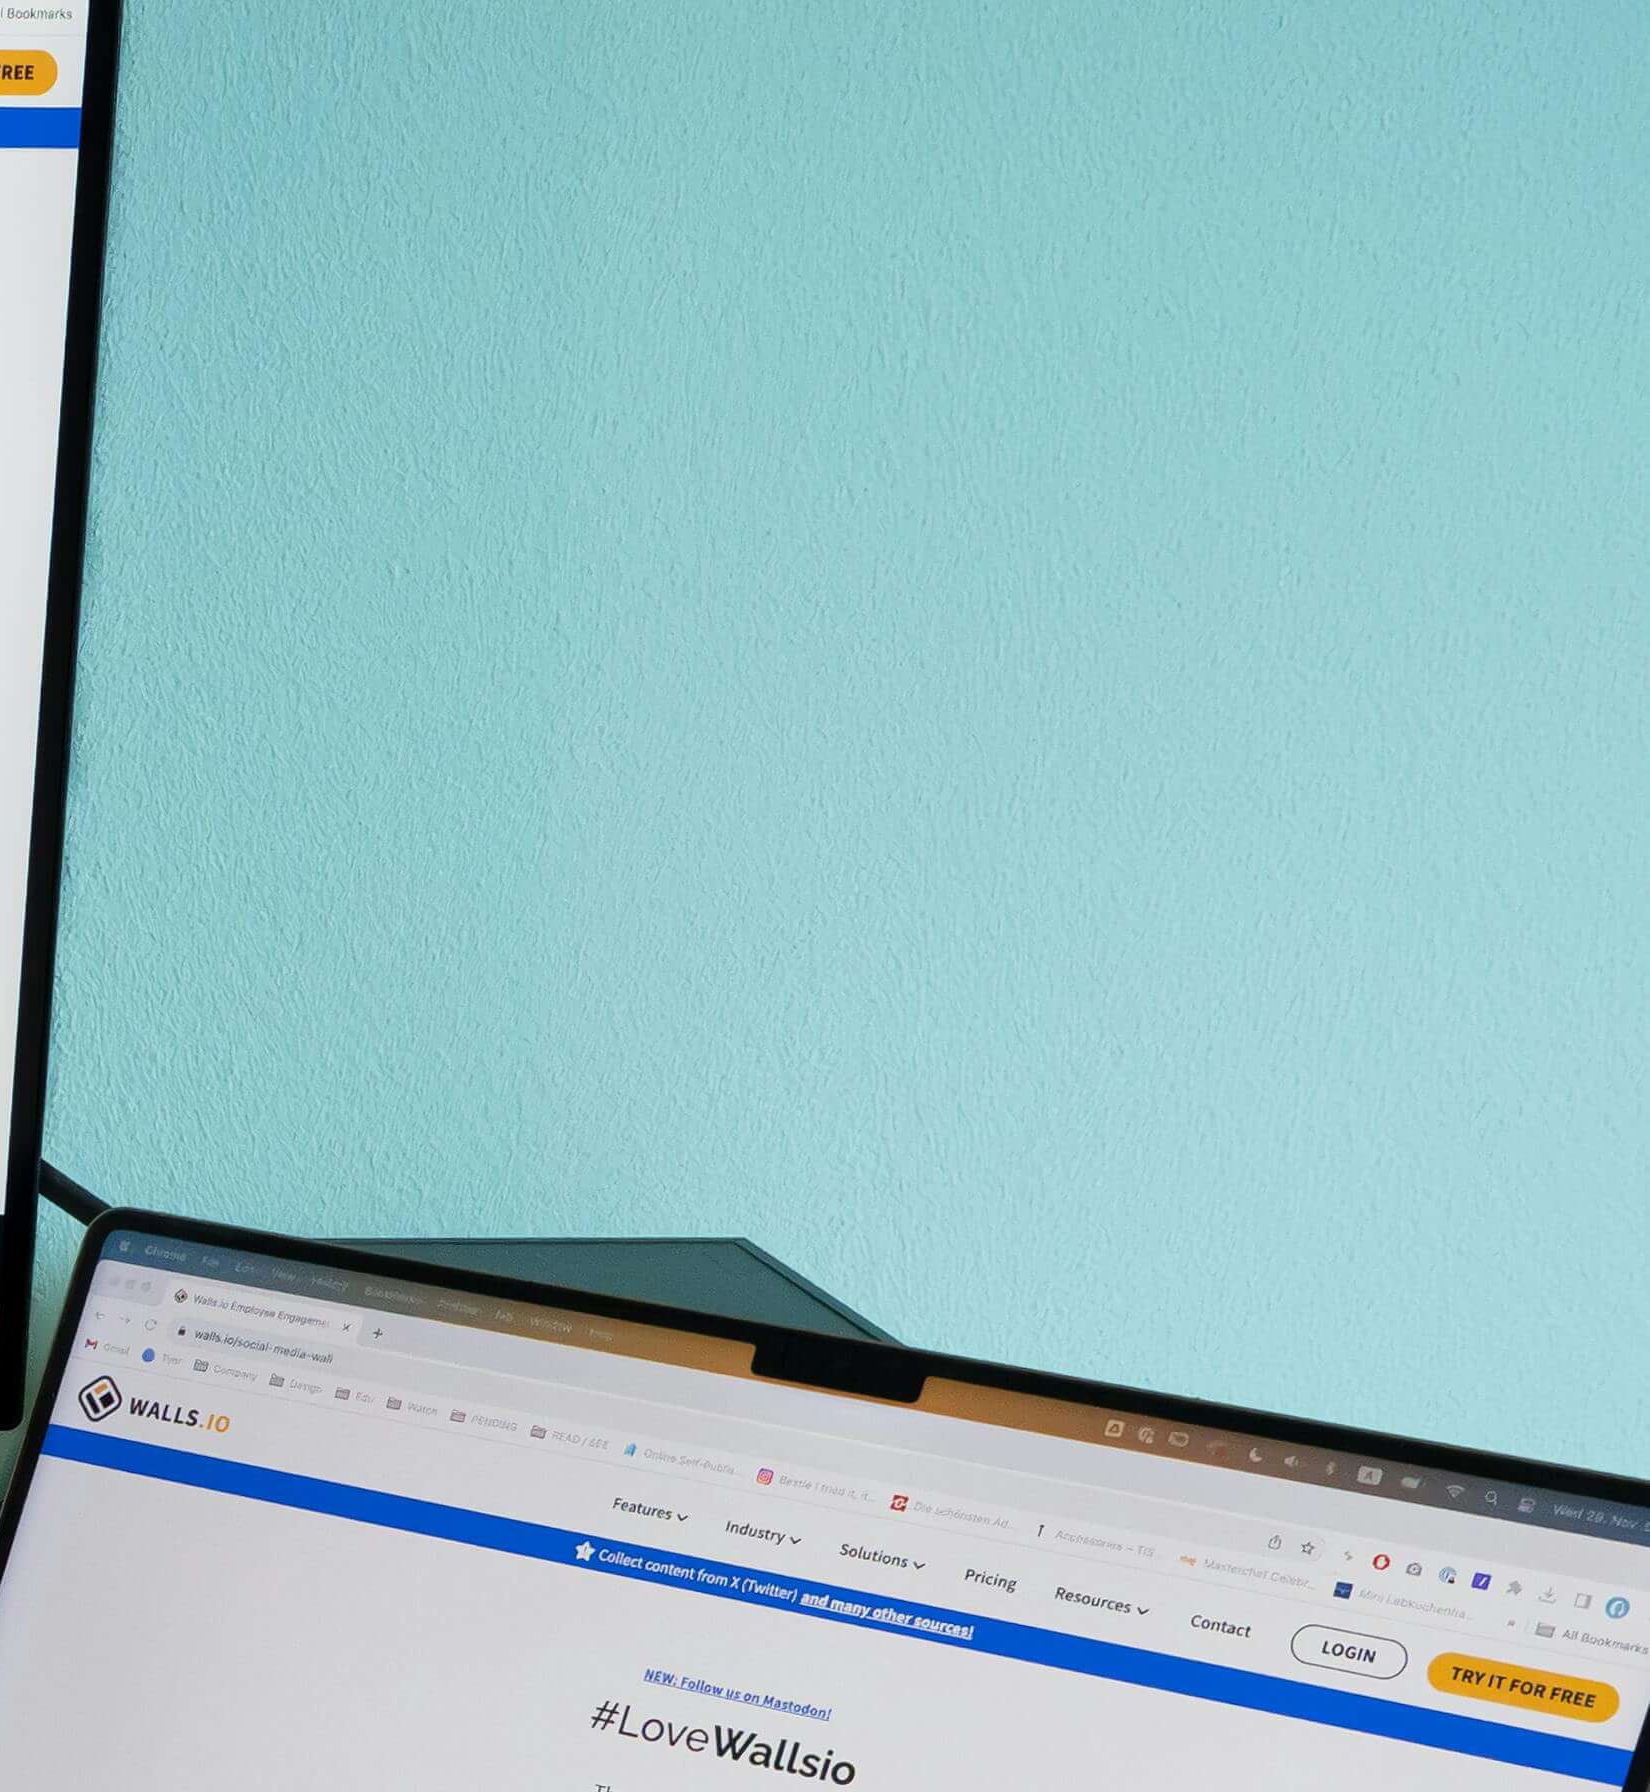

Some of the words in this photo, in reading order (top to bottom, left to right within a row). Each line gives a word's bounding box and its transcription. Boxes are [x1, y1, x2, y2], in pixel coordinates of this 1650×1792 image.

[7, 7, 73, 21] Bookmarks
[129, 1397, 229, 1432] WALLS.IO
[612, 1497, 673, 1521] Features
[725, 1520, 787, 1546] Industry
[839, 1543, 909, 1568] Solutions
[964, 1568, 1018, 1594] Pricing
[598, 1549, 643, 1569] Collect
[644, 1560, 695, 1580] content
[696, 1568, 729, 1587] from
[730, 1576, 741, 1589] X
[741, 1578, 798, 1603] (Twitter)
[800, 1593, 830, 1610] and
[827, 1599, 871, 1620] many
[869, 1608, 913, 1628] other
[911, 1617, 974, 1640] sources!
[1054, 1586, 1132, 1614] Resources
[1190, 1614, 1251, 1638] Contact
[1321, 1640, 1377, 1664] LOGIN
[1561, 1629, 1579, 1641] All
[1580, 1632, 1649, 1655] Bookmarks
[644, 1669, 678, 1687] NEW:
[680, 1676, 724, 1698] Follow
[724, 1689, 742, 1703] us
[740, 1692, 761, 1707] on
[759, 1695, 832, 1720] Mastodon!
[1452, 1666, 1486, 1686] TRY
[1487, 1674, 1507, 1690] IT
[1508, 1678, 1547, 1699] FOR
[1549, 1686, 1597, 1709] FREE
[591, 1700, 856, 1786] #LoveWallsio
